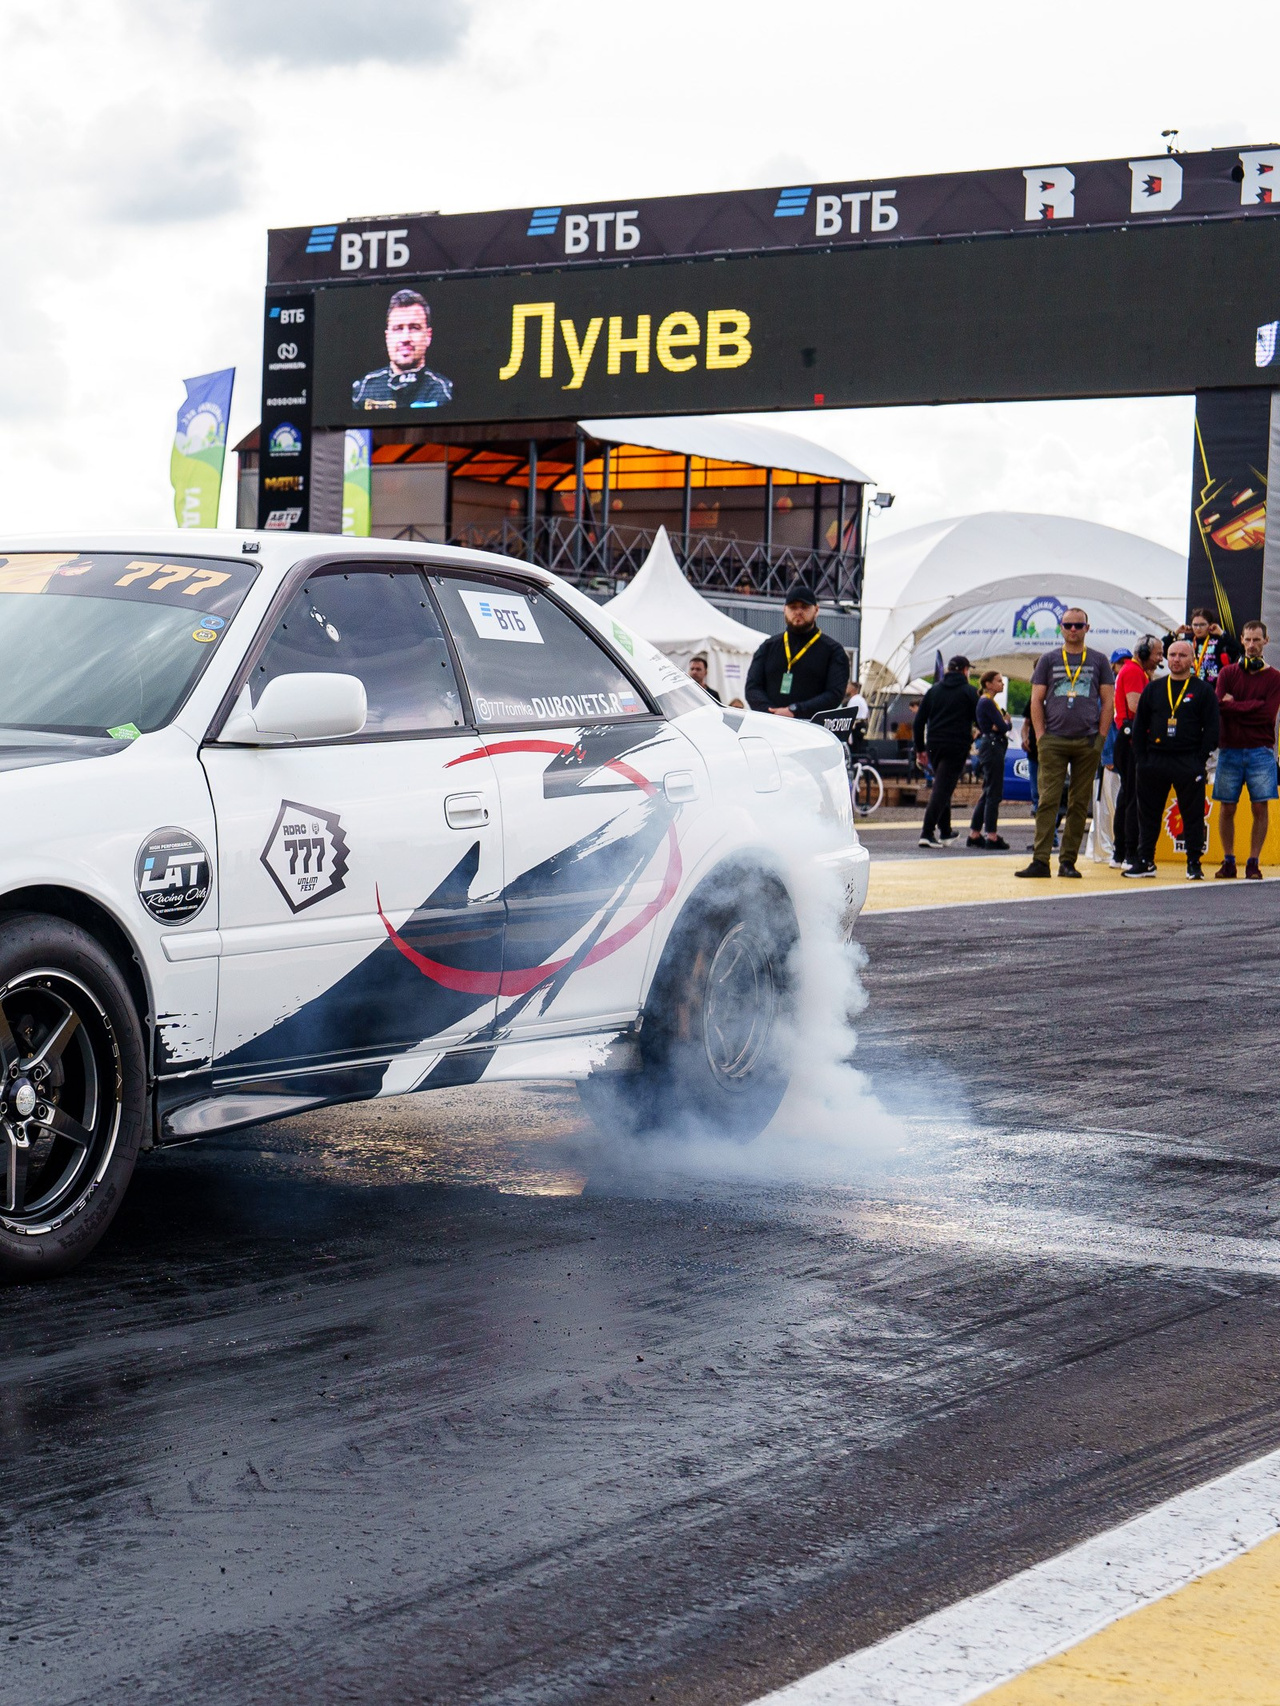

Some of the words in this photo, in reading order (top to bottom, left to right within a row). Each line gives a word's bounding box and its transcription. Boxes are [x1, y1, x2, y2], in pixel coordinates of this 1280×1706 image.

[815, 189, 899, 237] ВТБ
[564, 210, 641, 254] ВТБ
[340, 228, 410, 271] ВТБ
[280, 308, 306, 324] ВТБ
[499, 301, 753, 391] Лунев
[113, 560, 233, 596] 777
[493, 608, 526, 632] ВТБ
[488, 700, 534, 718] 777romka
[531, 692, 624, 719] DUBOVETS.R
[160, 841, 193, 850] PERFORMANCE
[282, 824, 307, 836] RDRC
[140, 852, 205, 892] LAT
[283, 837, 326, 876] 777
[145, 892, 185, 908] Racing
[185, 887, 207, 902] Oils
[300, 883, 317, 892] FEST
